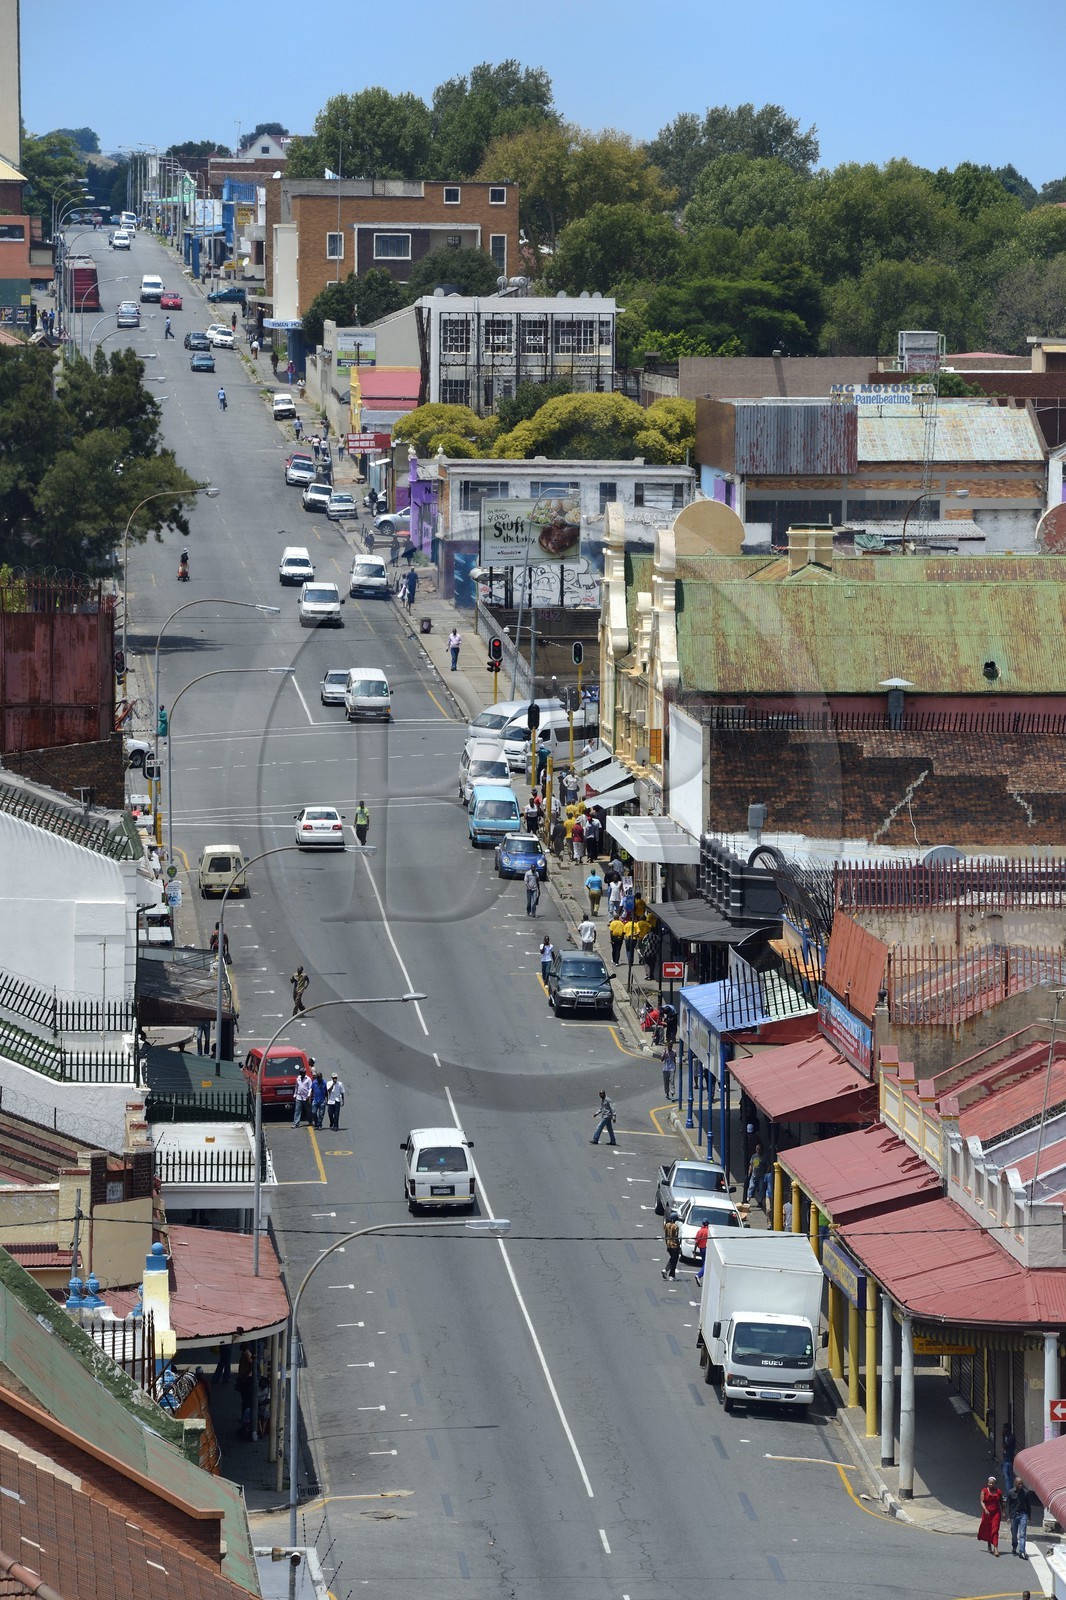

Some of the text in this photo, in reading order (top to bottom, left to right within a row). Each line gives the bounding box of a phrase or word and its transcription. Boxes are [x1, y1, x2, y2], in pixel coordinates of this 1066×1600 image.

[832, 384, 855, 393] MG
[861, 384, 918, 393] MOTORS
[855, 394, 911, 405] Panelbeating
